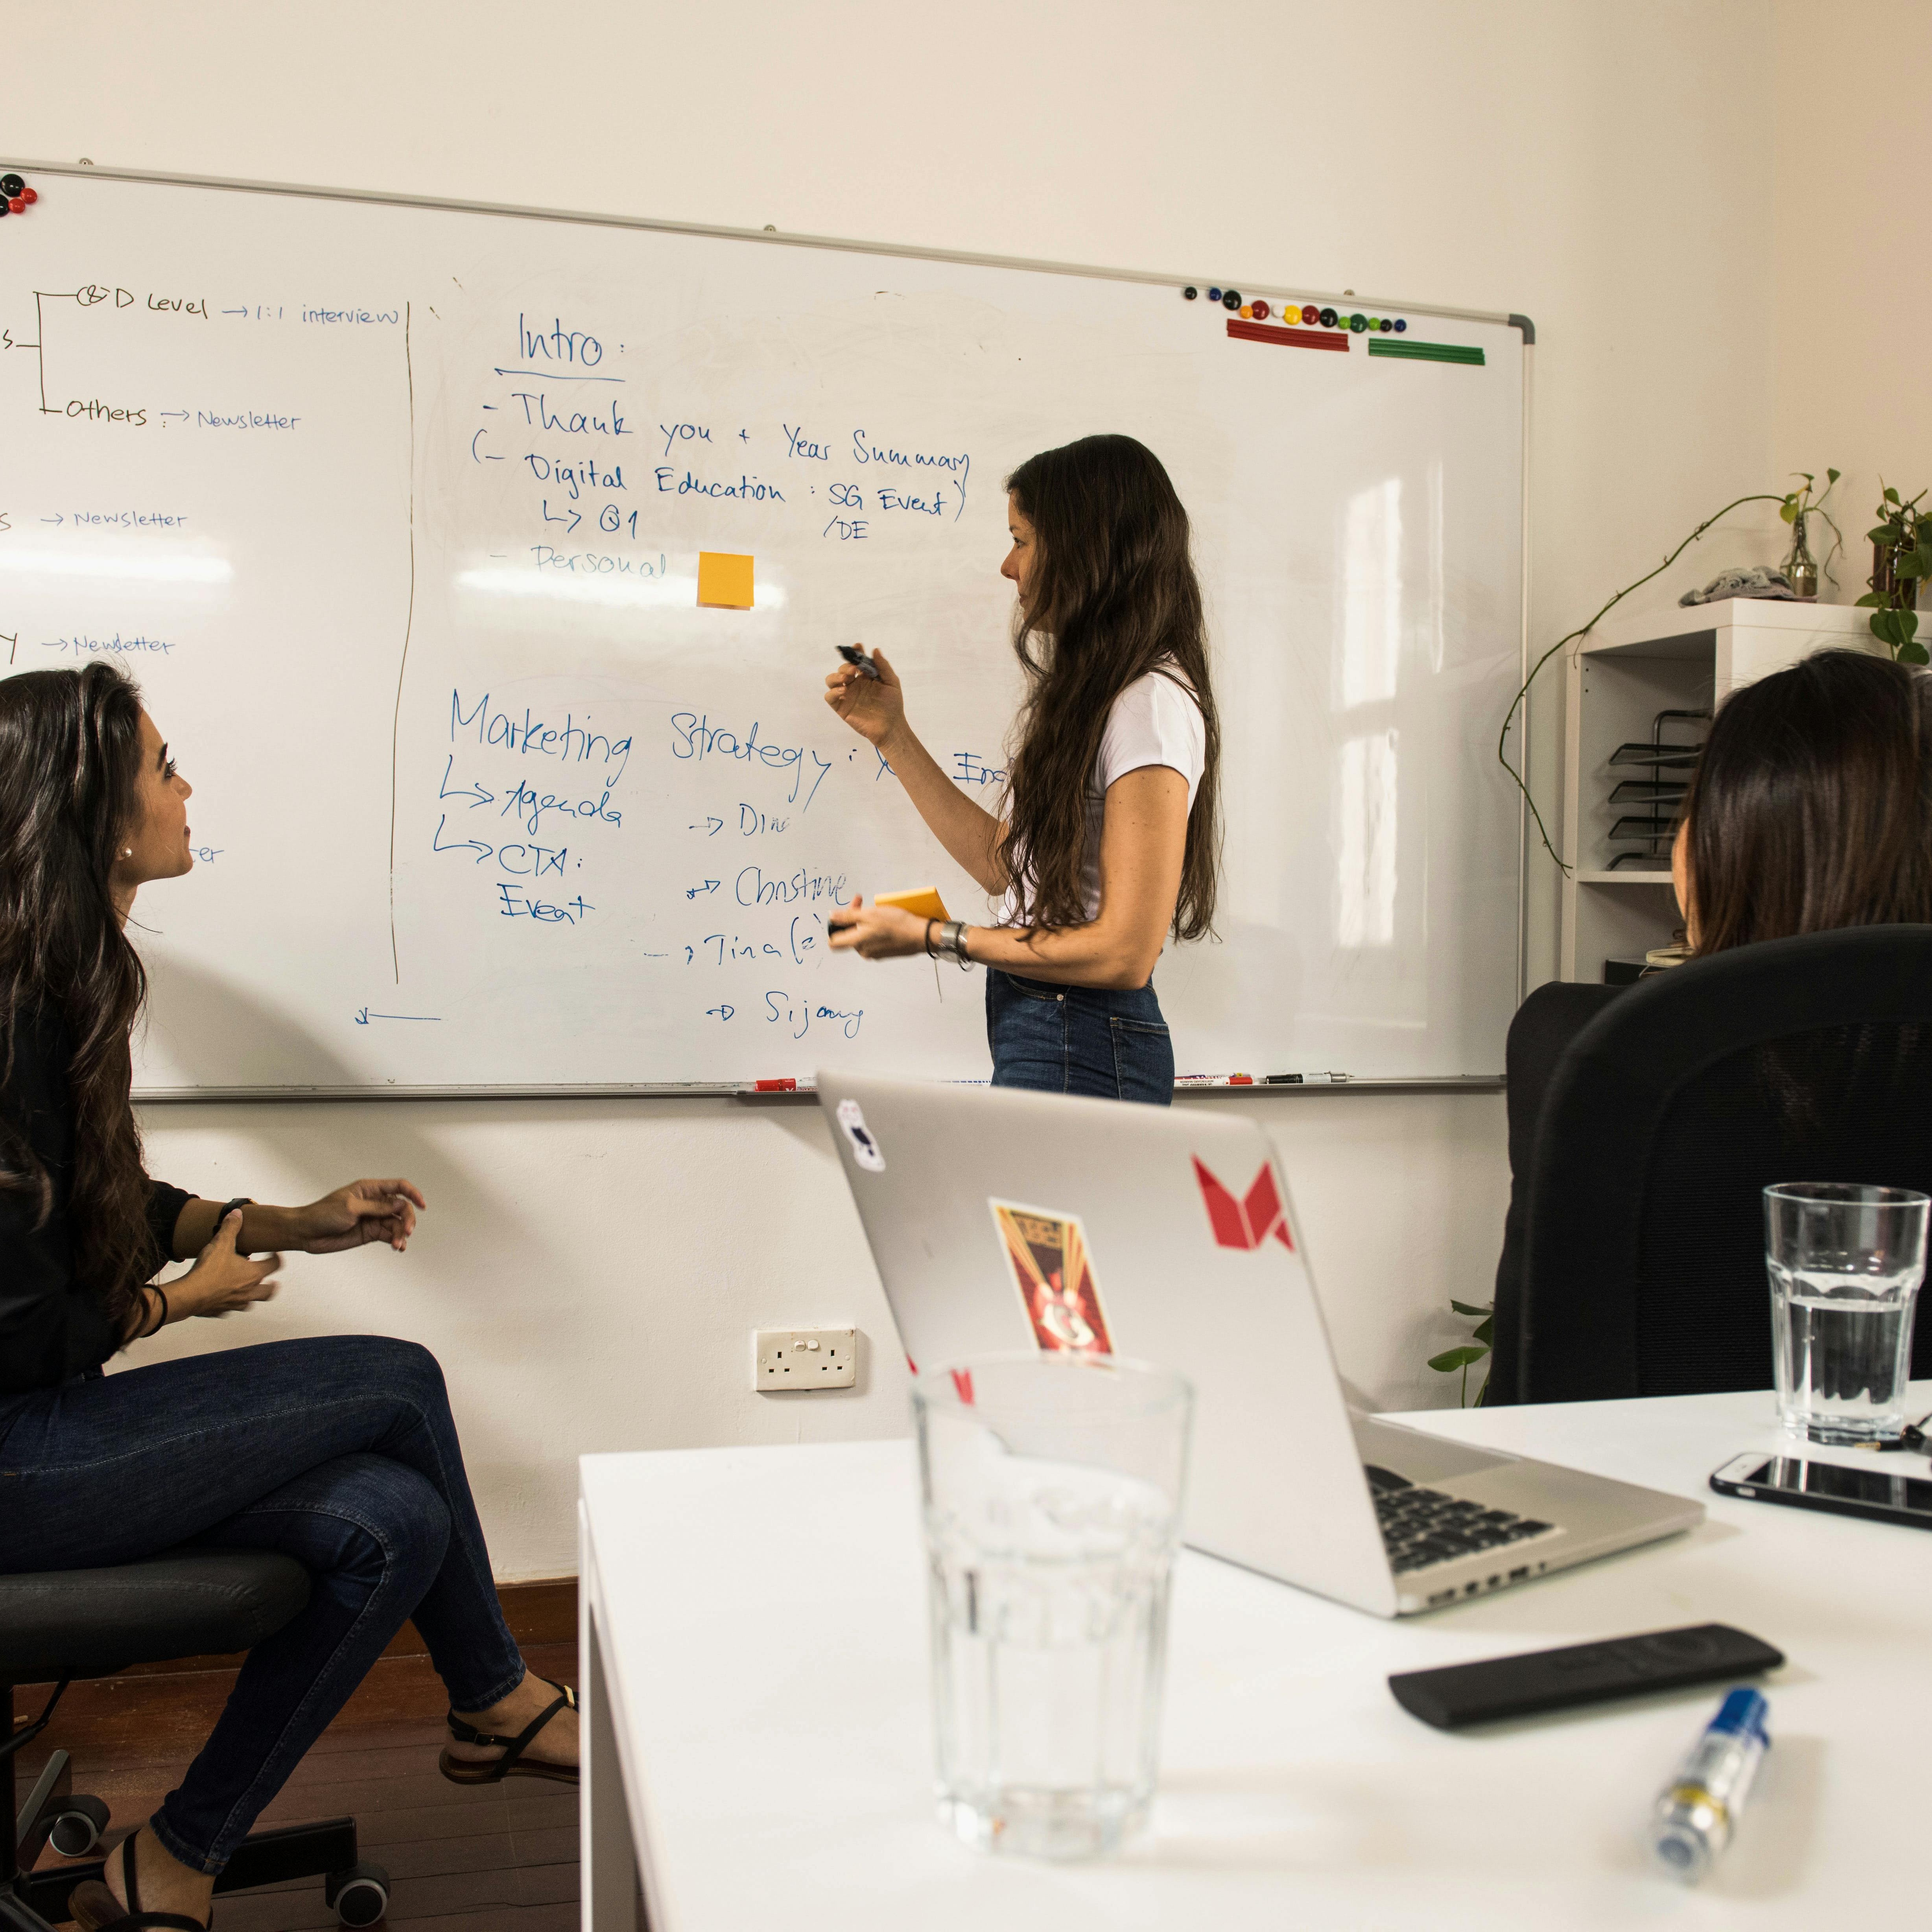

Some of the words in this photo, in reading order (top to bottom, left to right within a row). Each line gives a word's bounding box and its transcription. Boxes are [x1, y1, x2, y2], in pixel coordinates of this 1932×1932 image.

[302, 305, 398, 324] interview
[197, 409, 302, 431] Newsletter
[511, 393, 633, 435] Thank
[660, 424, 713, 457] you
[783, 424, 831, 460] Year
[853, 430, 970, 497] Summary
[524, 454, 628, 500] Digital
[654, 467, 786, 502] Education
[829, 483, 863, 511] SG
[74, 511, 188, 528] Newsletter
[531, 545, 666, 579] Personal
[450, 689, 632, 787] Marketing
[501, 780, 622, 836] Agenda
[497, 883, 596, 925] Event
